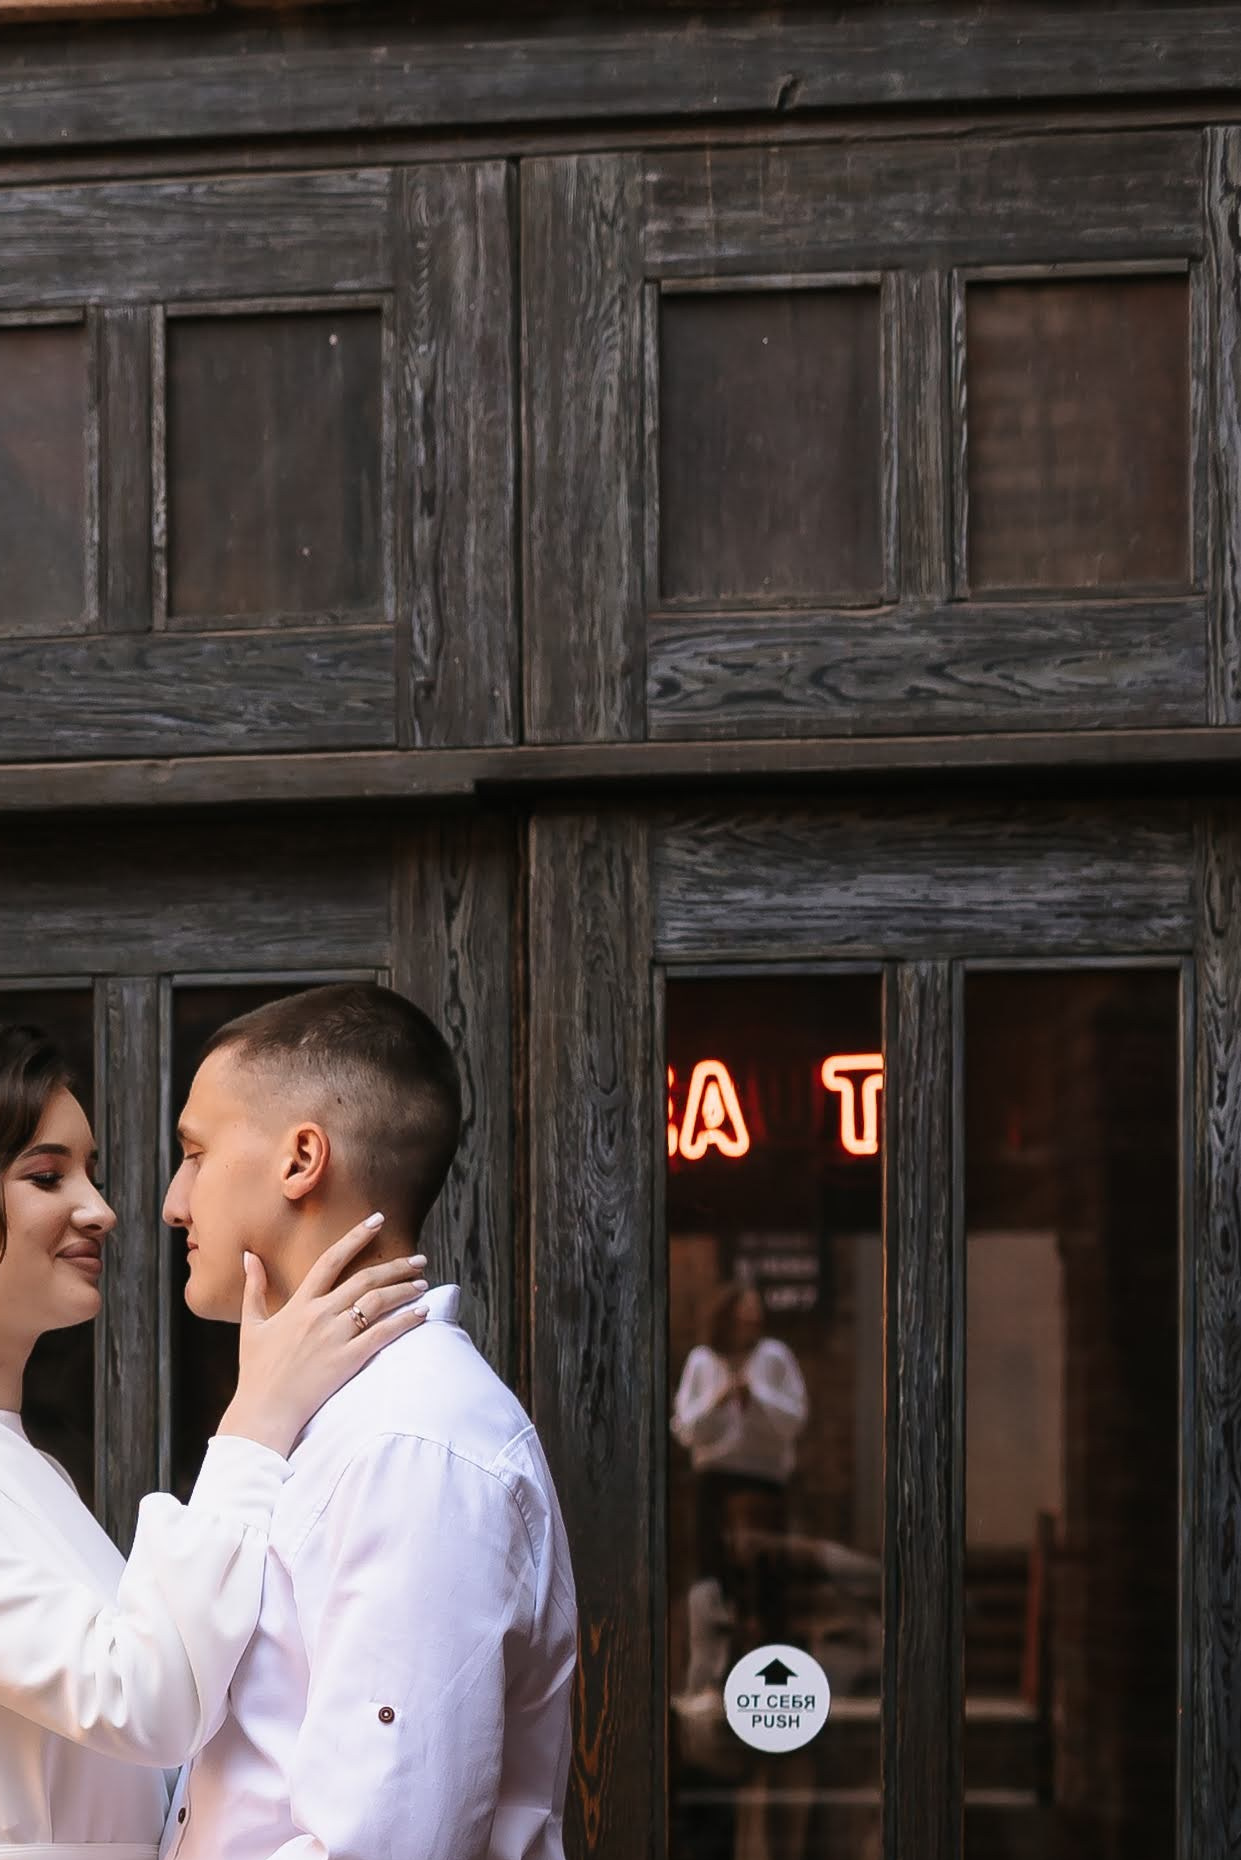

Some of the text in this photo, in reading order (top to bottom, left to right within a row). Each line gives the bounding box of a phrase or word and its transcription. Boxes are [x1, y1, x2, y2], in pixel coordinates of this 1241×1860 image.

[667, 1059, 750, 1160] А
[737, 1694, 815, 1708] ОТ СЕБЯ
[752, 1714, 800, 1728] PUSH
